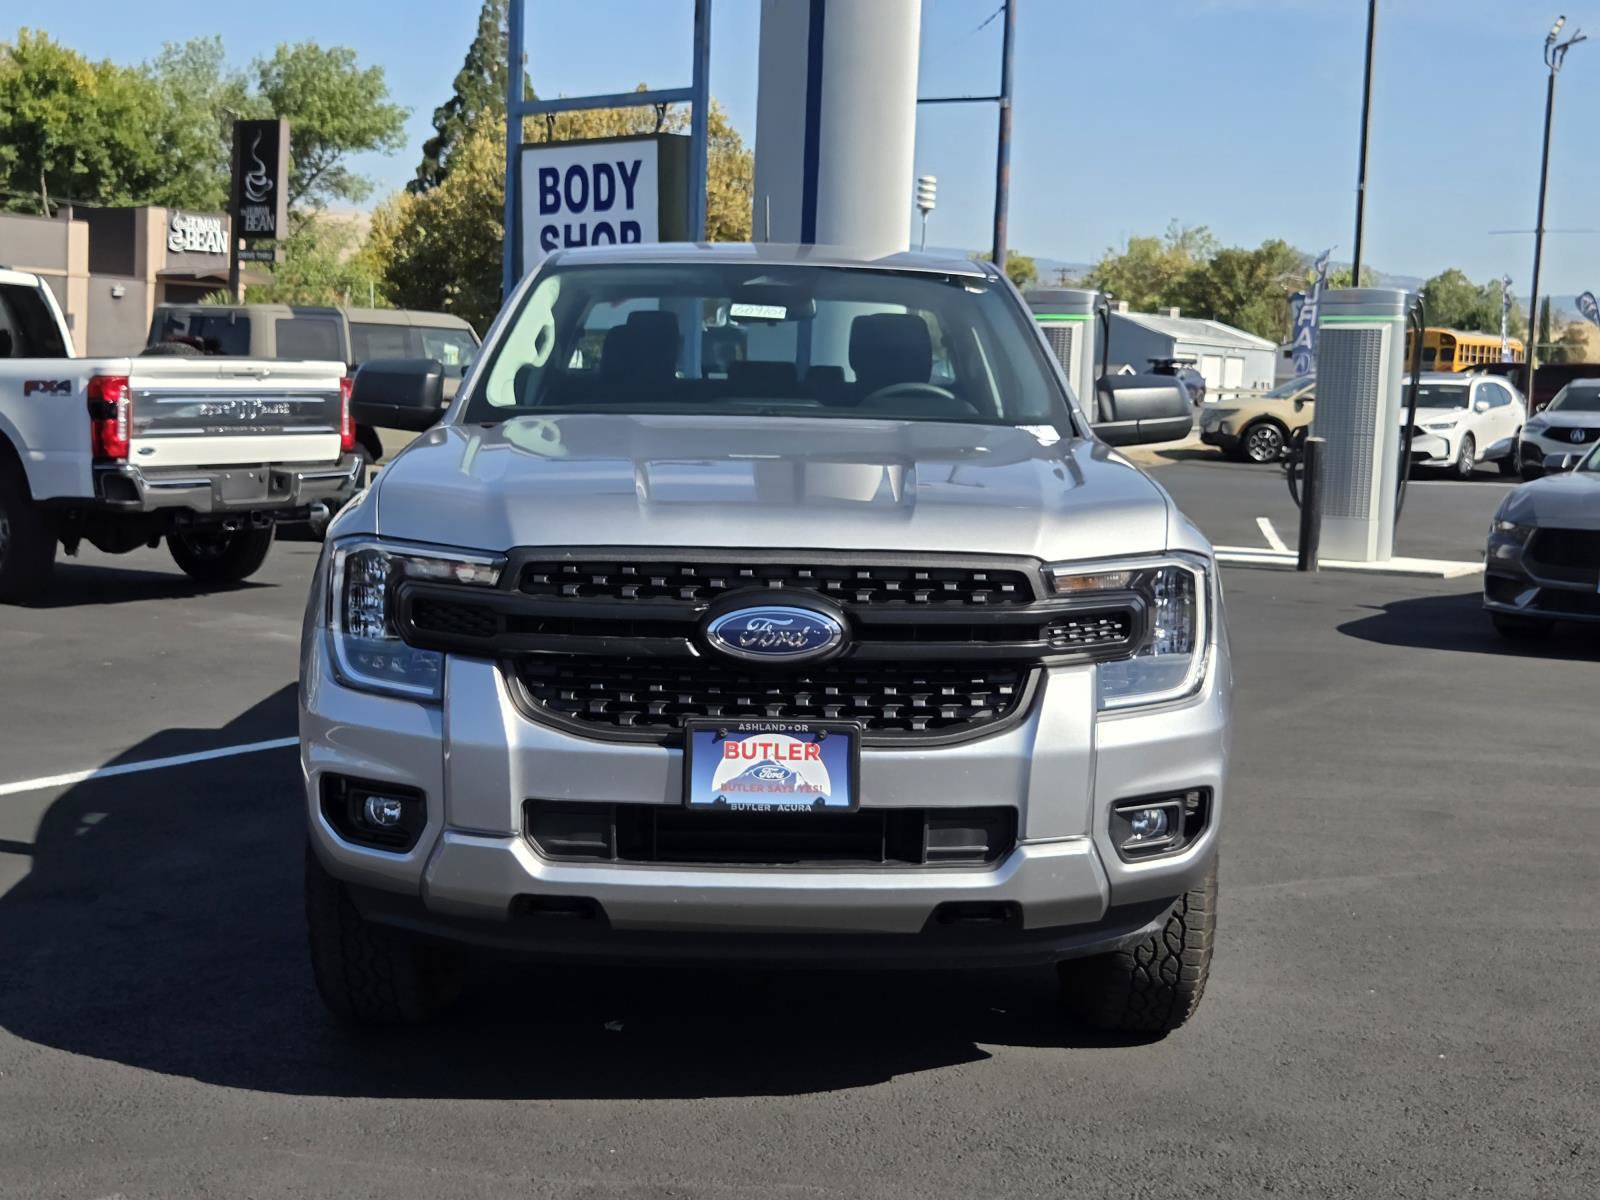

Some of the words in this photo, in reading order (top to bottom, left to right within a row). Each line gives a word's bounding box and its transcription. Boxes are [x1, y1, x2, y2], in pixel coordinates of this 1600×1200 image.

[538, 159, 643, 216] BODY
[245, 215, 275, 232] BEAN
[186, 229, 229, 254] BEAN
[24, 379, 72, 397] FX4
[738, 617, 811, 648] Ford
[738, 722, 786, 732] ASHLAND
[795, 724, 809, 732] OR
[724, 740, 821, 761] BUTLER
[758, 767, 785, 780] Ford
[720, 783, 765, 793] BUTLER
[767, 783, 797, 793] SAYS
[799, 784, 823, 793] YES!
[730, 803, 771, 812] BUTLER
[777, 803, 812, 812] ACURA
